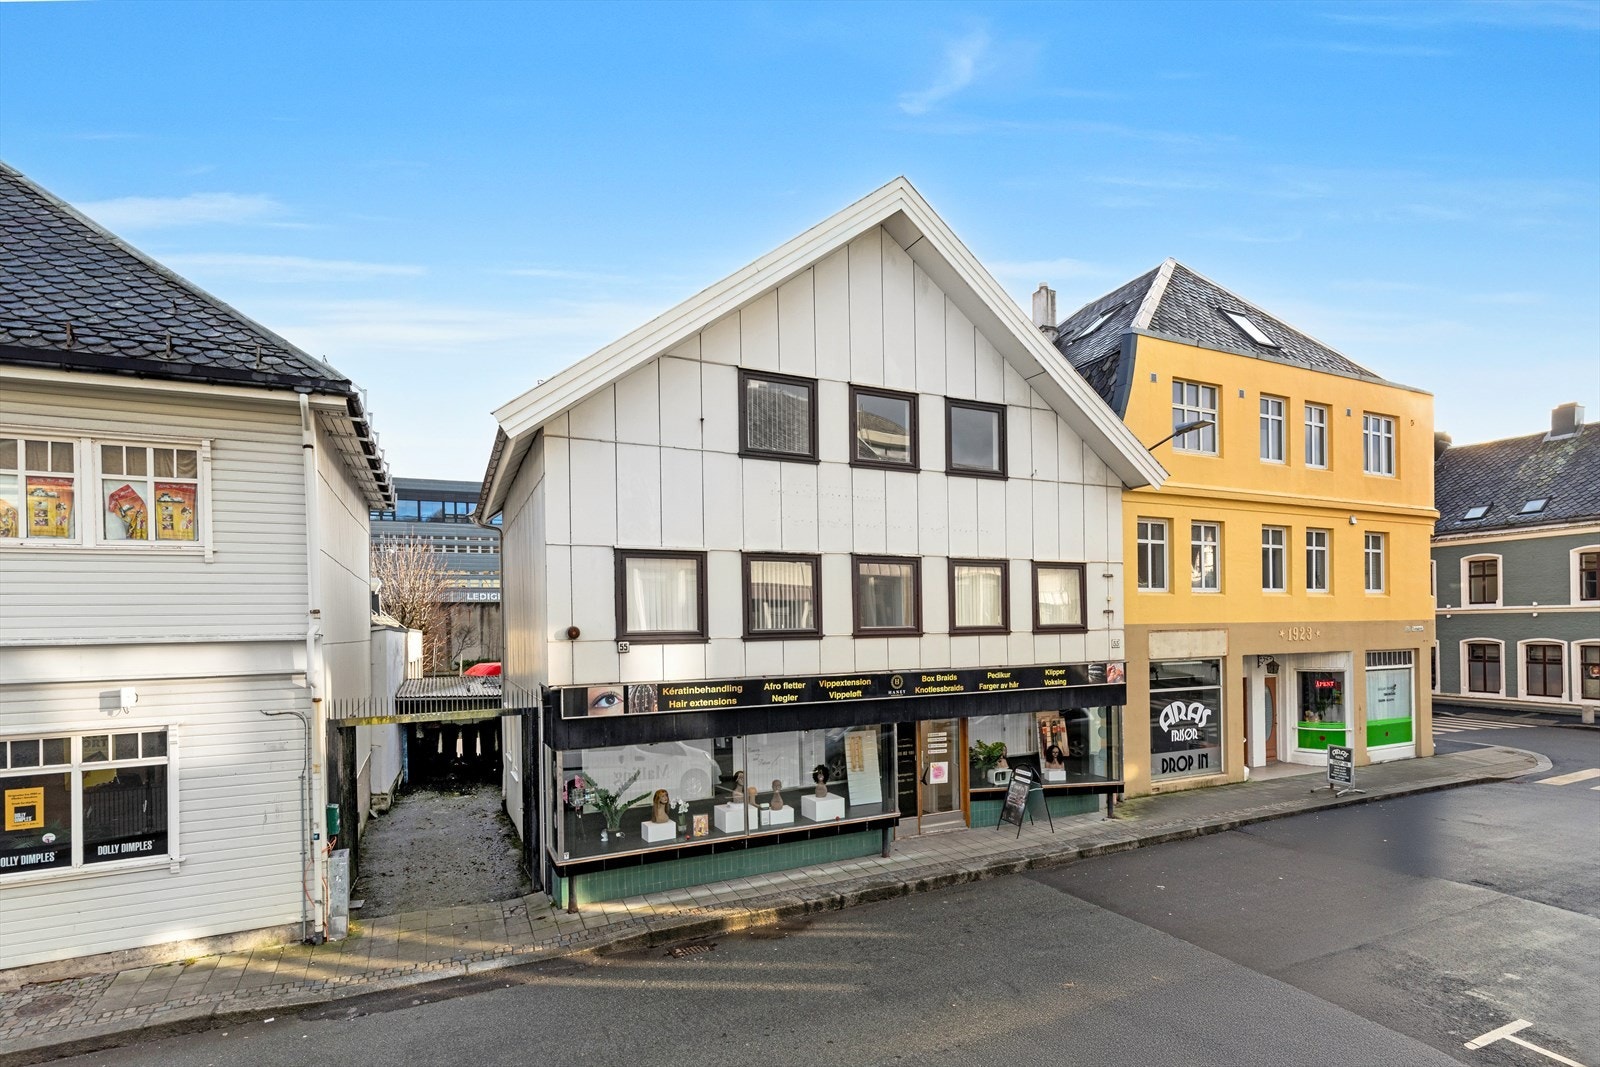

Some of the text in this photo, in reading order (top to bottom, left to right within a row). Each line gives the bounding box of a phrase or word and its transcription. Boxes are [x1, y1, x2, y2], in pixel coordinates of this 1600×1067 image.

[1287, 626, 1313, 641] 1923
[619, 643, 628, 651] 55
[987, 671, 1011, 679] Pedikur
[1044, 668, 1066, 676] Klipper
[936, 674, 958, 682] Braids
[763, 682, 806, 690] Afro fletter
[819, 678, 872, 689] Vippextension
[978, 683, 999, 691] Farger
[662, 684, 743, 696] Kératinbehandling
[914, 684, 964, 694] Knotlessbraids
[668, 698, 737, 708] Hair extensions
[771, 694, 799, 703] Negler
[1159, 700, 1212, 733] ARAS
[1171, 727, 1199, 742] FRISØR
[1161, 753, 1209, 774] DROP IN
[97, 840, 153, 856] DOLLY DIMPLES
[20, 851, 55, 866] DIMPLES
